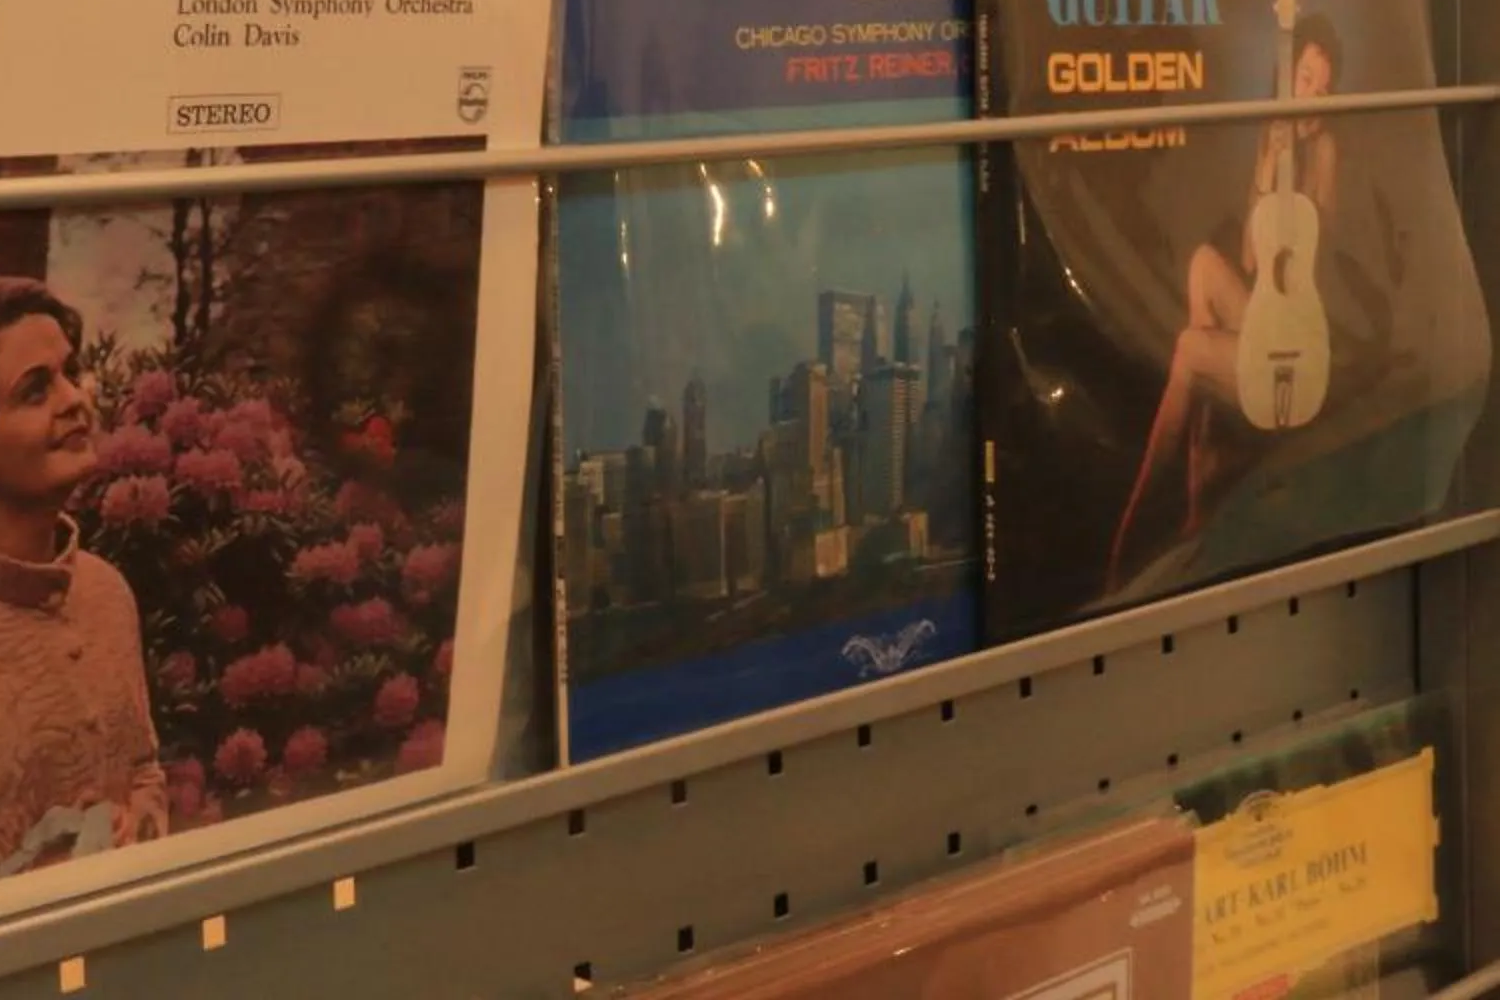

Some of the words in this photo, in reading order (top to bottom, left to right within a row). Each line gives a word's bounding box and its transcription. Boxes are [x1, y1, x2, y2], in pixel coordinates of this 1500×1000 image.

[173, 24, 230, 48] Colin
[244, 24, 300, 47] Davis
[735, 23, 828, 51] CHICAGO
[831, 21, 935, 45] SYMPHONY
[784, 54, 862, 85] FRITZ
[1047, 51, 1204, 94] GOLDEN
[176, 102, 272, 127] STEREO
